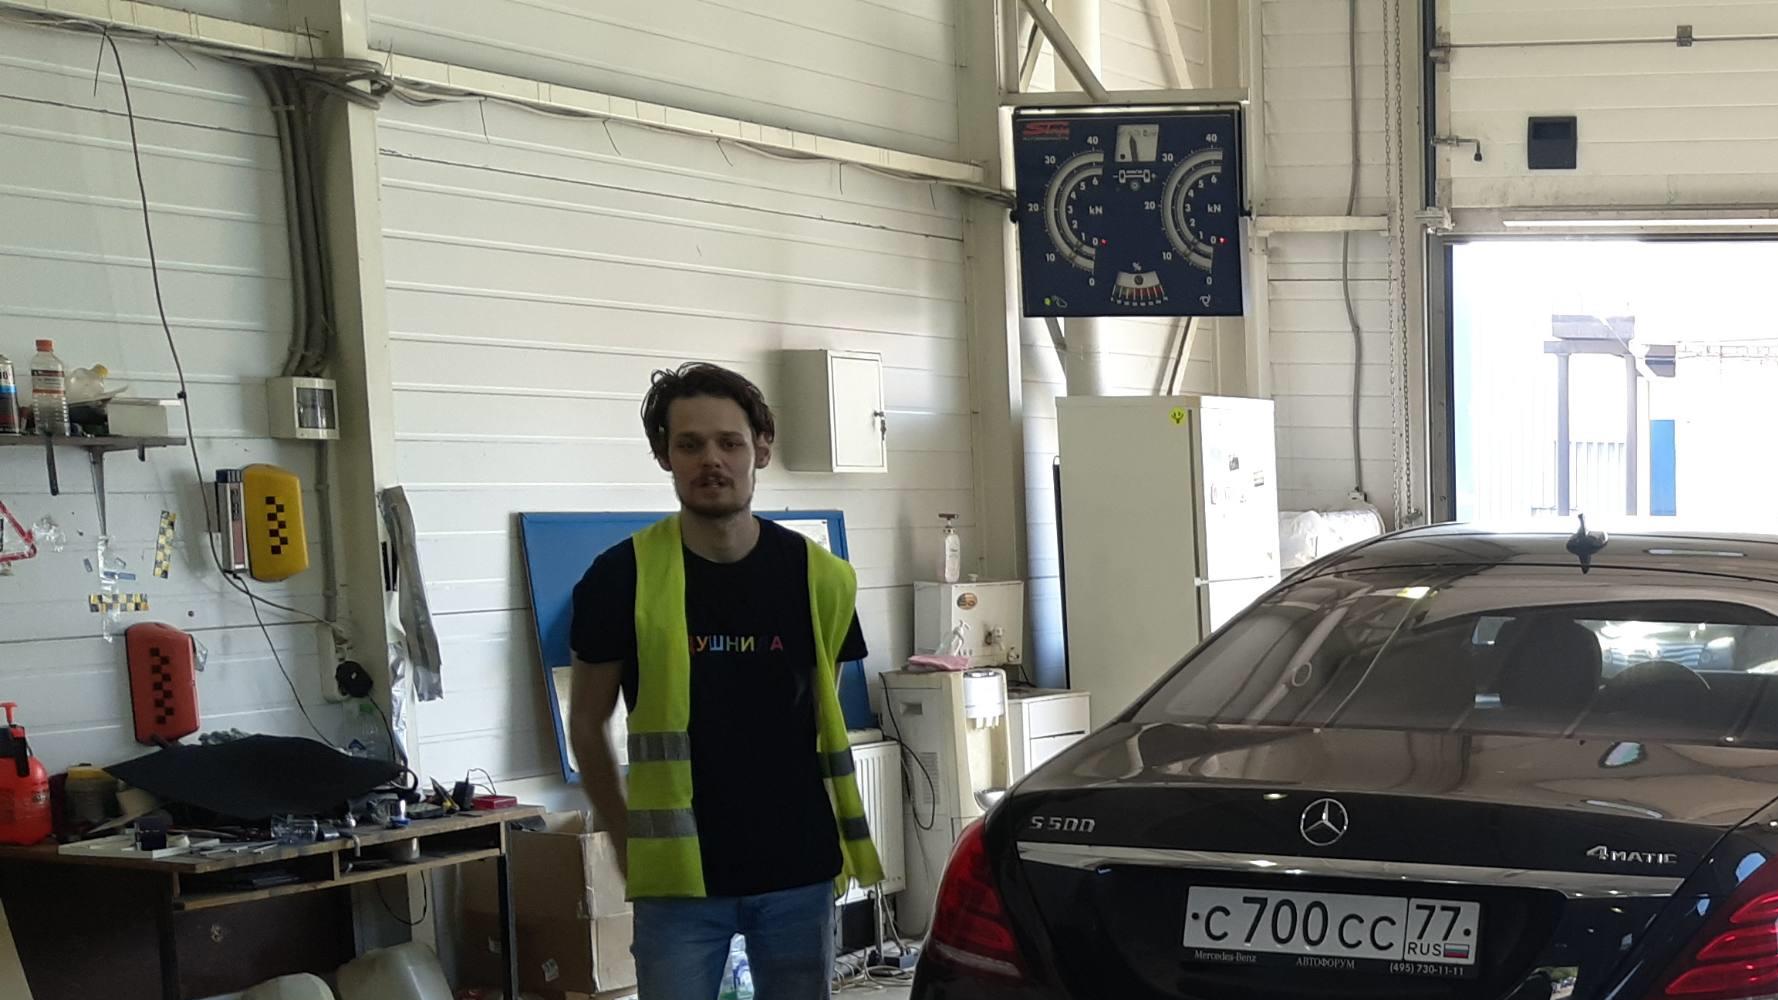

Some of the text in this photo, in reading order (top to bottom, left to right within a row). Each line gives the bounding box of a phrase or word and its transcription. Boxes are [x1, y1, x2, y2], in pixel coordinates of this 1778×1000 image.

[1087, 136, 1099, 145] 40
[1206, 134, 1217, 142] 40
[1044, 155, 1056, 164] 30
[1162, 153, 1173, 162] 30
[1028, 203, 1039, 212] 20
[1144, 201, 1155, 209] 20
[1207, 204, 1221, 213] kN
[1089, 206, 1103, 215] kN
[1045, 254, 1055, 262] 10
[1162, 252, 1172, 260] 10
[1029, 816, 1096, 832] S 500
[1586, 845, 1678, 864] 4MATIC
[1415, 904, 1461, 941] 77
[1407, 941, 1442, 957] RUS
[1194, 950, 1257, 963] Mercedes-Benz
[1296, 957, 1355, 969] АВТОФОРУМ
[1389, 962, 1464, 976] (495) 730-11-11
